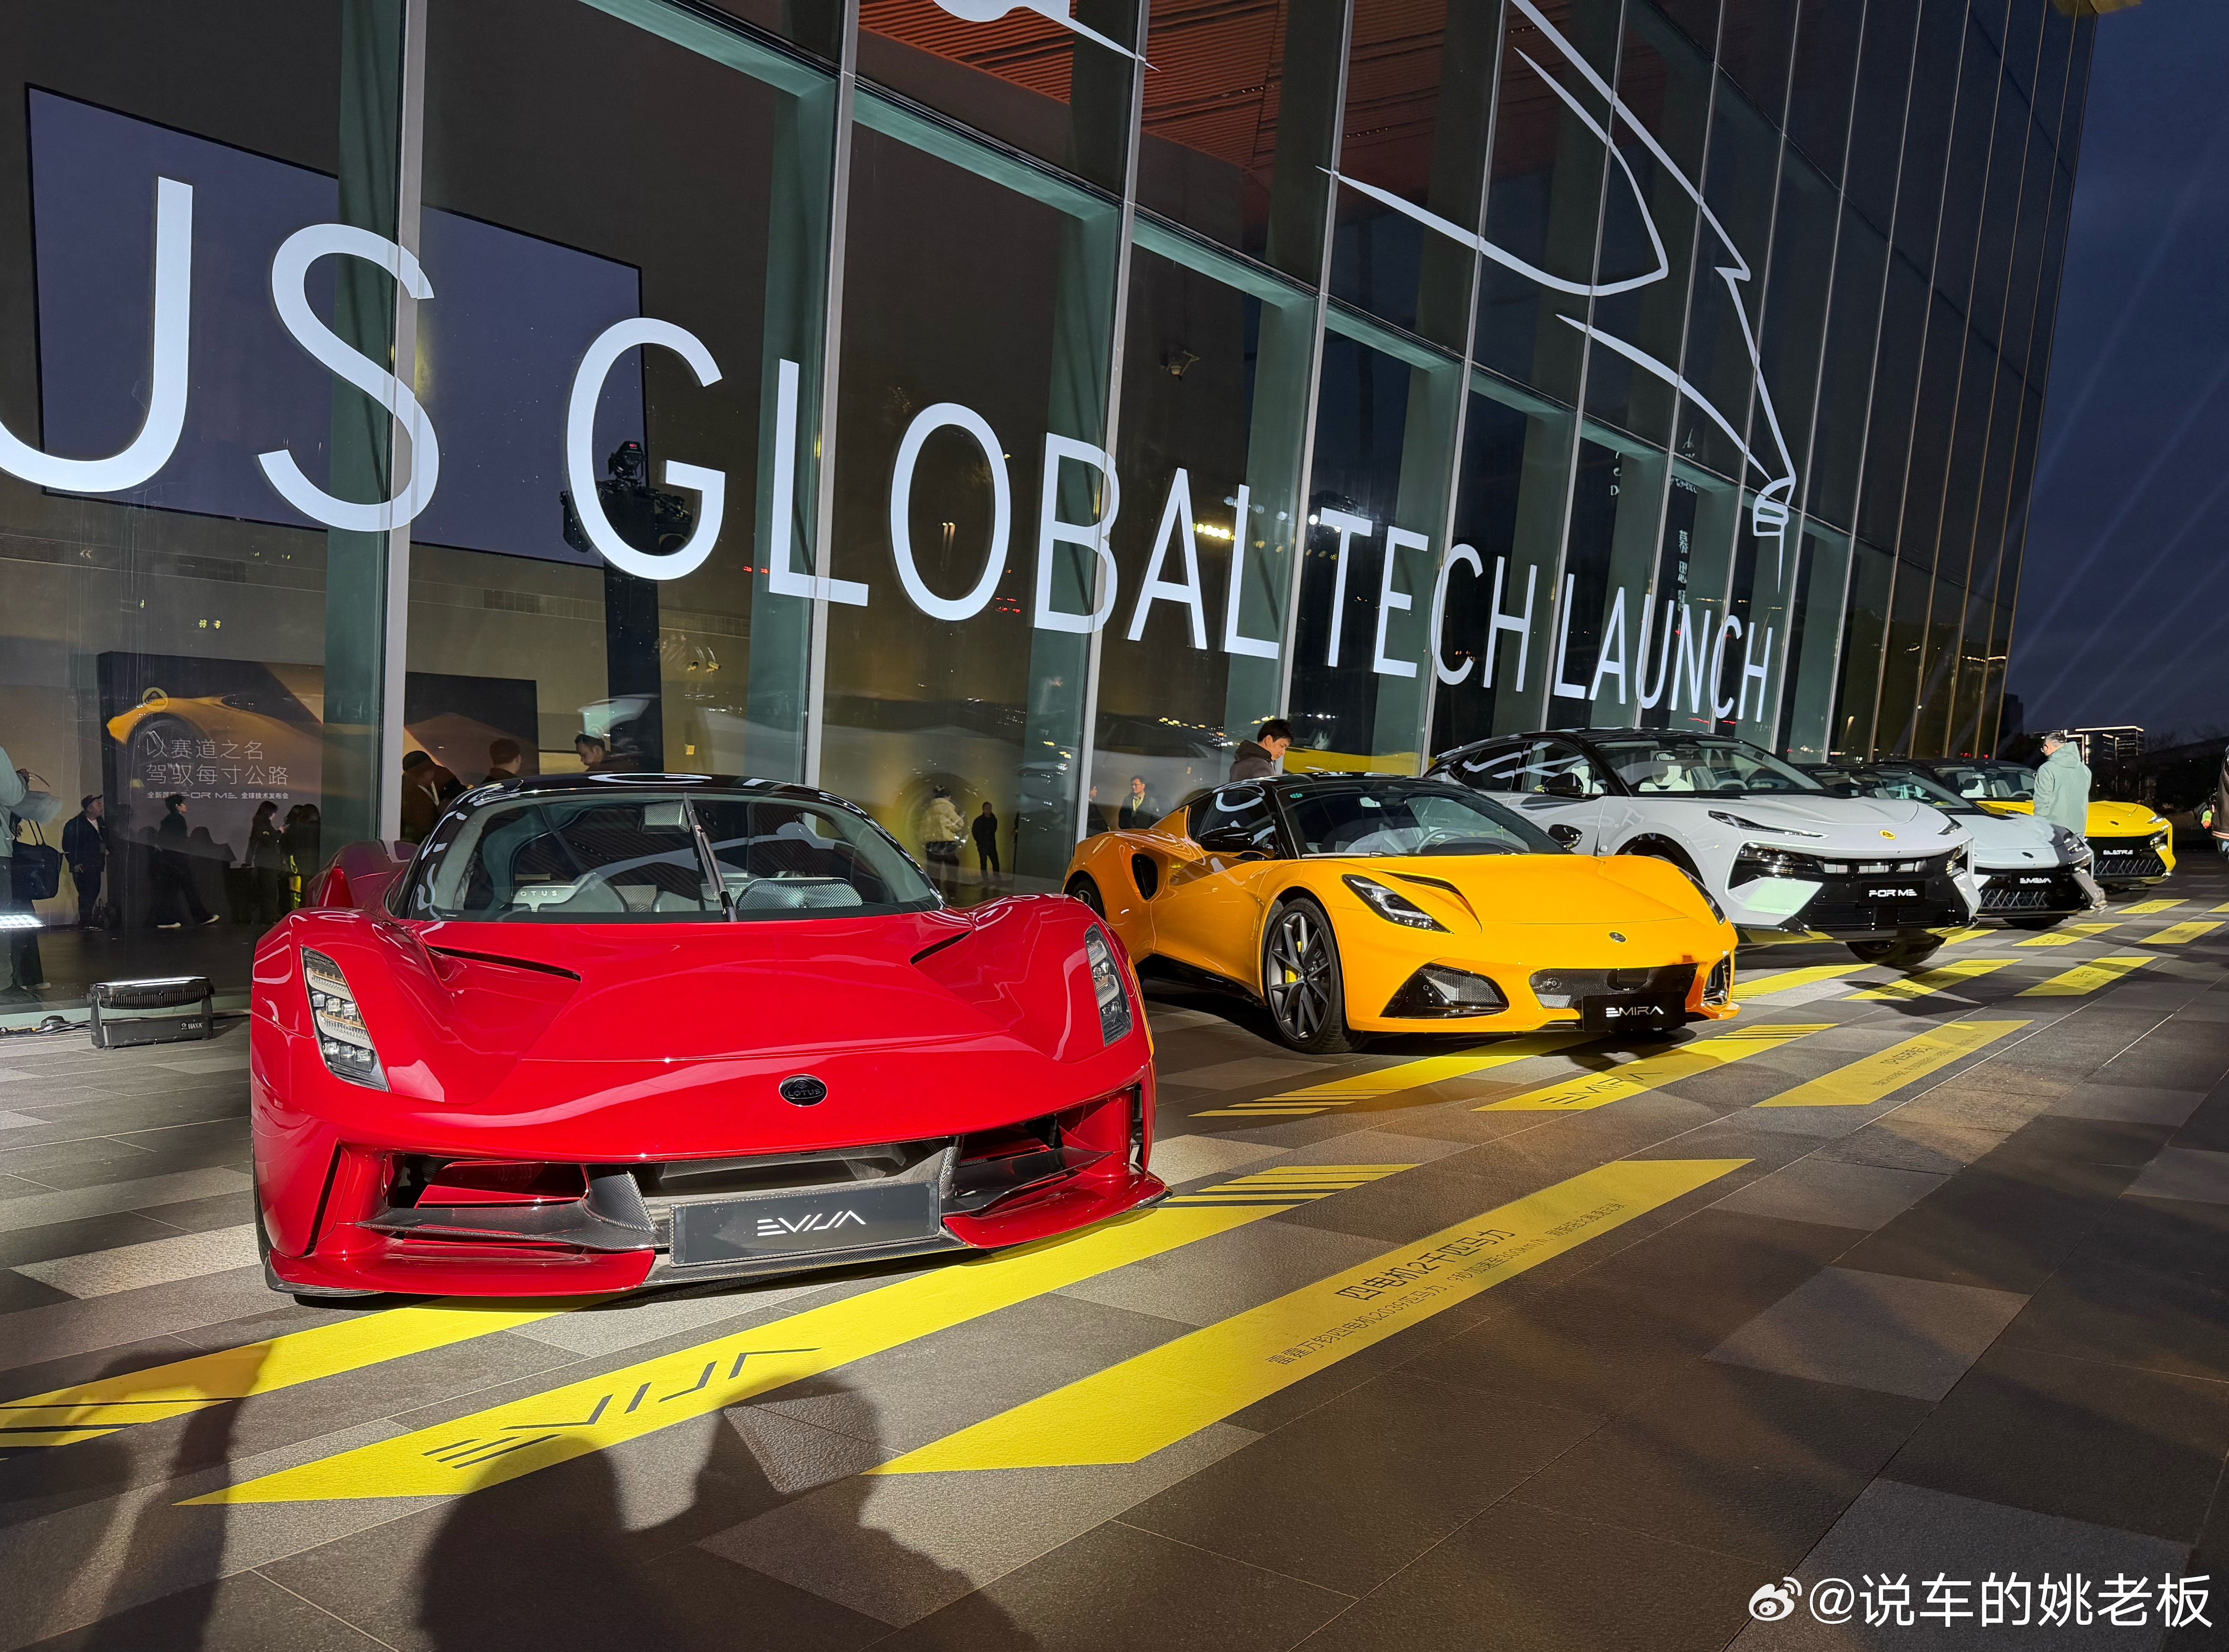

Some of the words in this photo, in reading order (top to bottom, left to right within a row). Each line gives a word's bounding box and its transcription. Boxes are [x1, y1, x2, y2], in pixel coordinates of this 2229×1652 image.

[567, 318, 1279, 659] GLOBAL
[1320, 507, 1537, 692] TECH
[1554, 574, 1773, 722] LAUNCH
[147, 737, 263, 760] 以赛道之名
[146, 763, 289, 786] 驾驭每寸公路
[1606, 1006, 1664, 1018] EMIRA
[1539, 1072, 1663, 1104] EMIRA
[757, 1210, 866, 1236] EVIJA
[1334, 1229, 1516, 1300] 四电机2千匹马力
[421, 1347, 823, 1469] EVIJA
